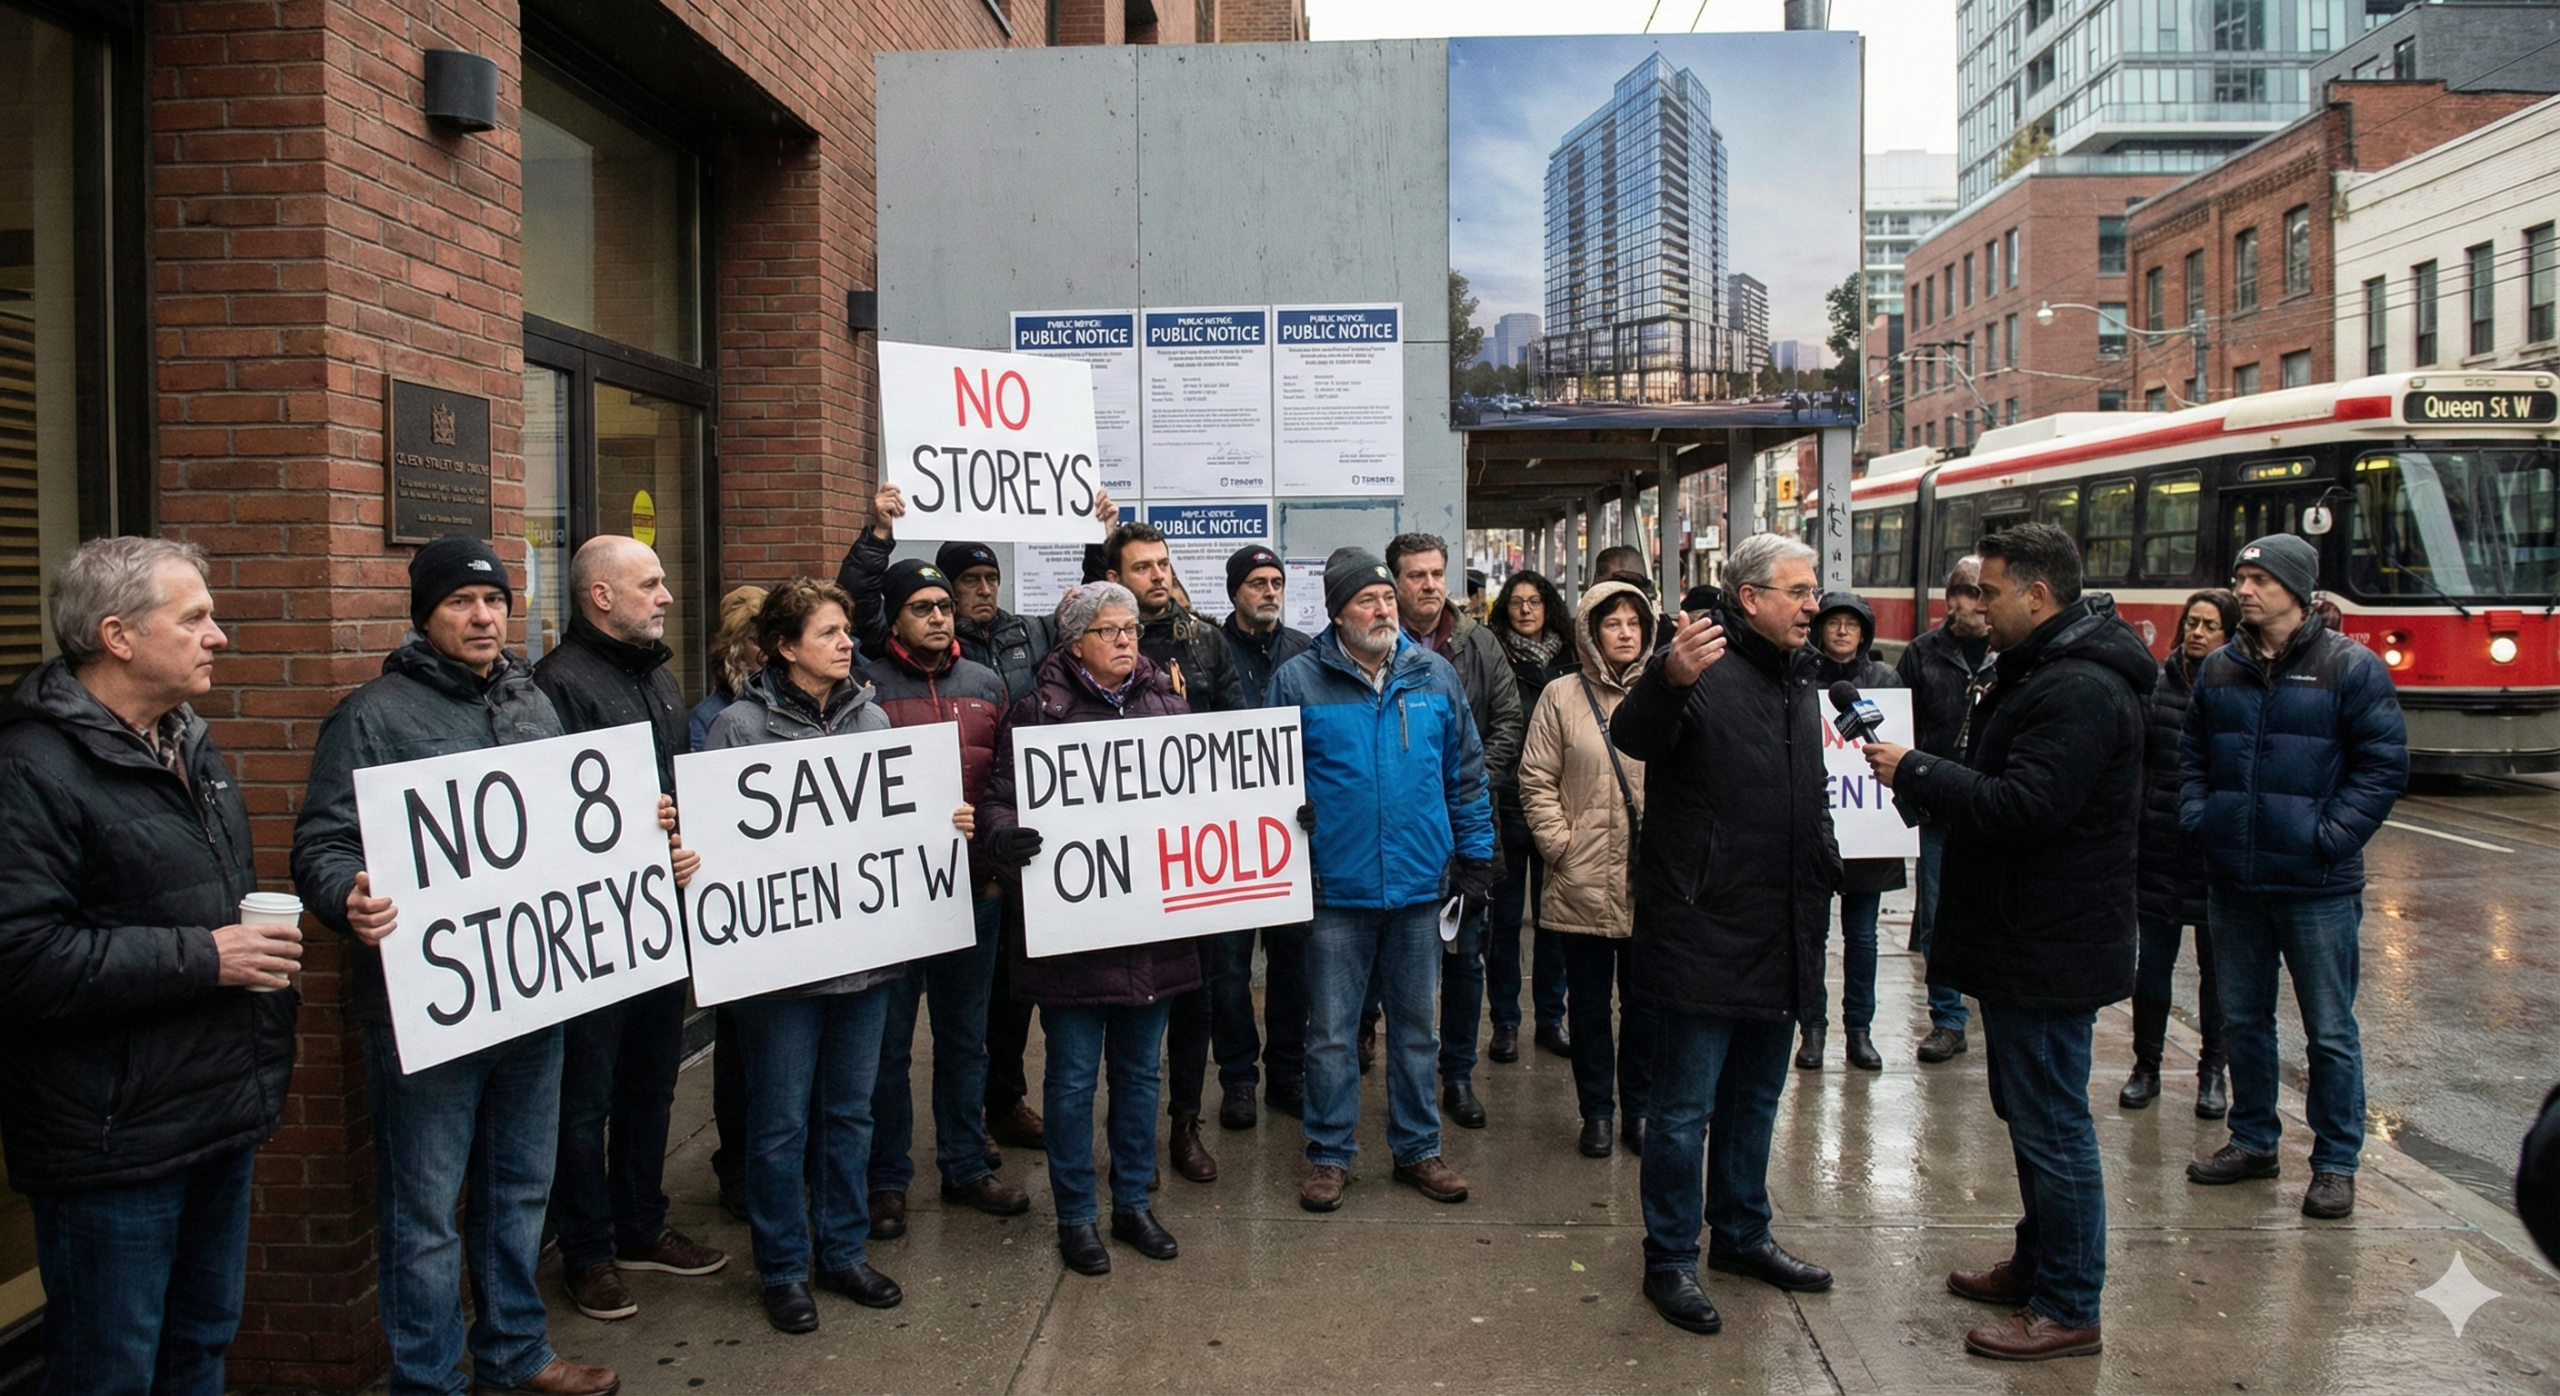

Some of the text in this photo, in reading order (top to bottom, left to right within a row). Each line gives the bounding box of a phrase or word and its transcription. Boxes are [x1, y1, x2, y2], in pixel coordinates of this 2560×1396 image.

[1021, 328, 1128, 345] PUBLIC NOTICE
[1151, 326, 1260, 342] PUBLIC NOTICE
[1283, 323, 1393, 340] PUBLIC NOTICE
[953, 366, 1031, 432] NO
[2425, 395, 2533, 419] Queen St W
[911, 444, 1089, 517] STOREYS
[1154, 519, 1262, 535] PUBLIC NOTICE
[737, 744, 917, 840] SAVE
[1023, 724, 1299, 810] DEVELOPMENT
[404, 748, 623, 890] NO 8
[696, 837, 960, 946] QUEEN ST W
[1054, 816, 1292, 904] ON HOLD
[421, 864, 673, 1027] STOREYS
